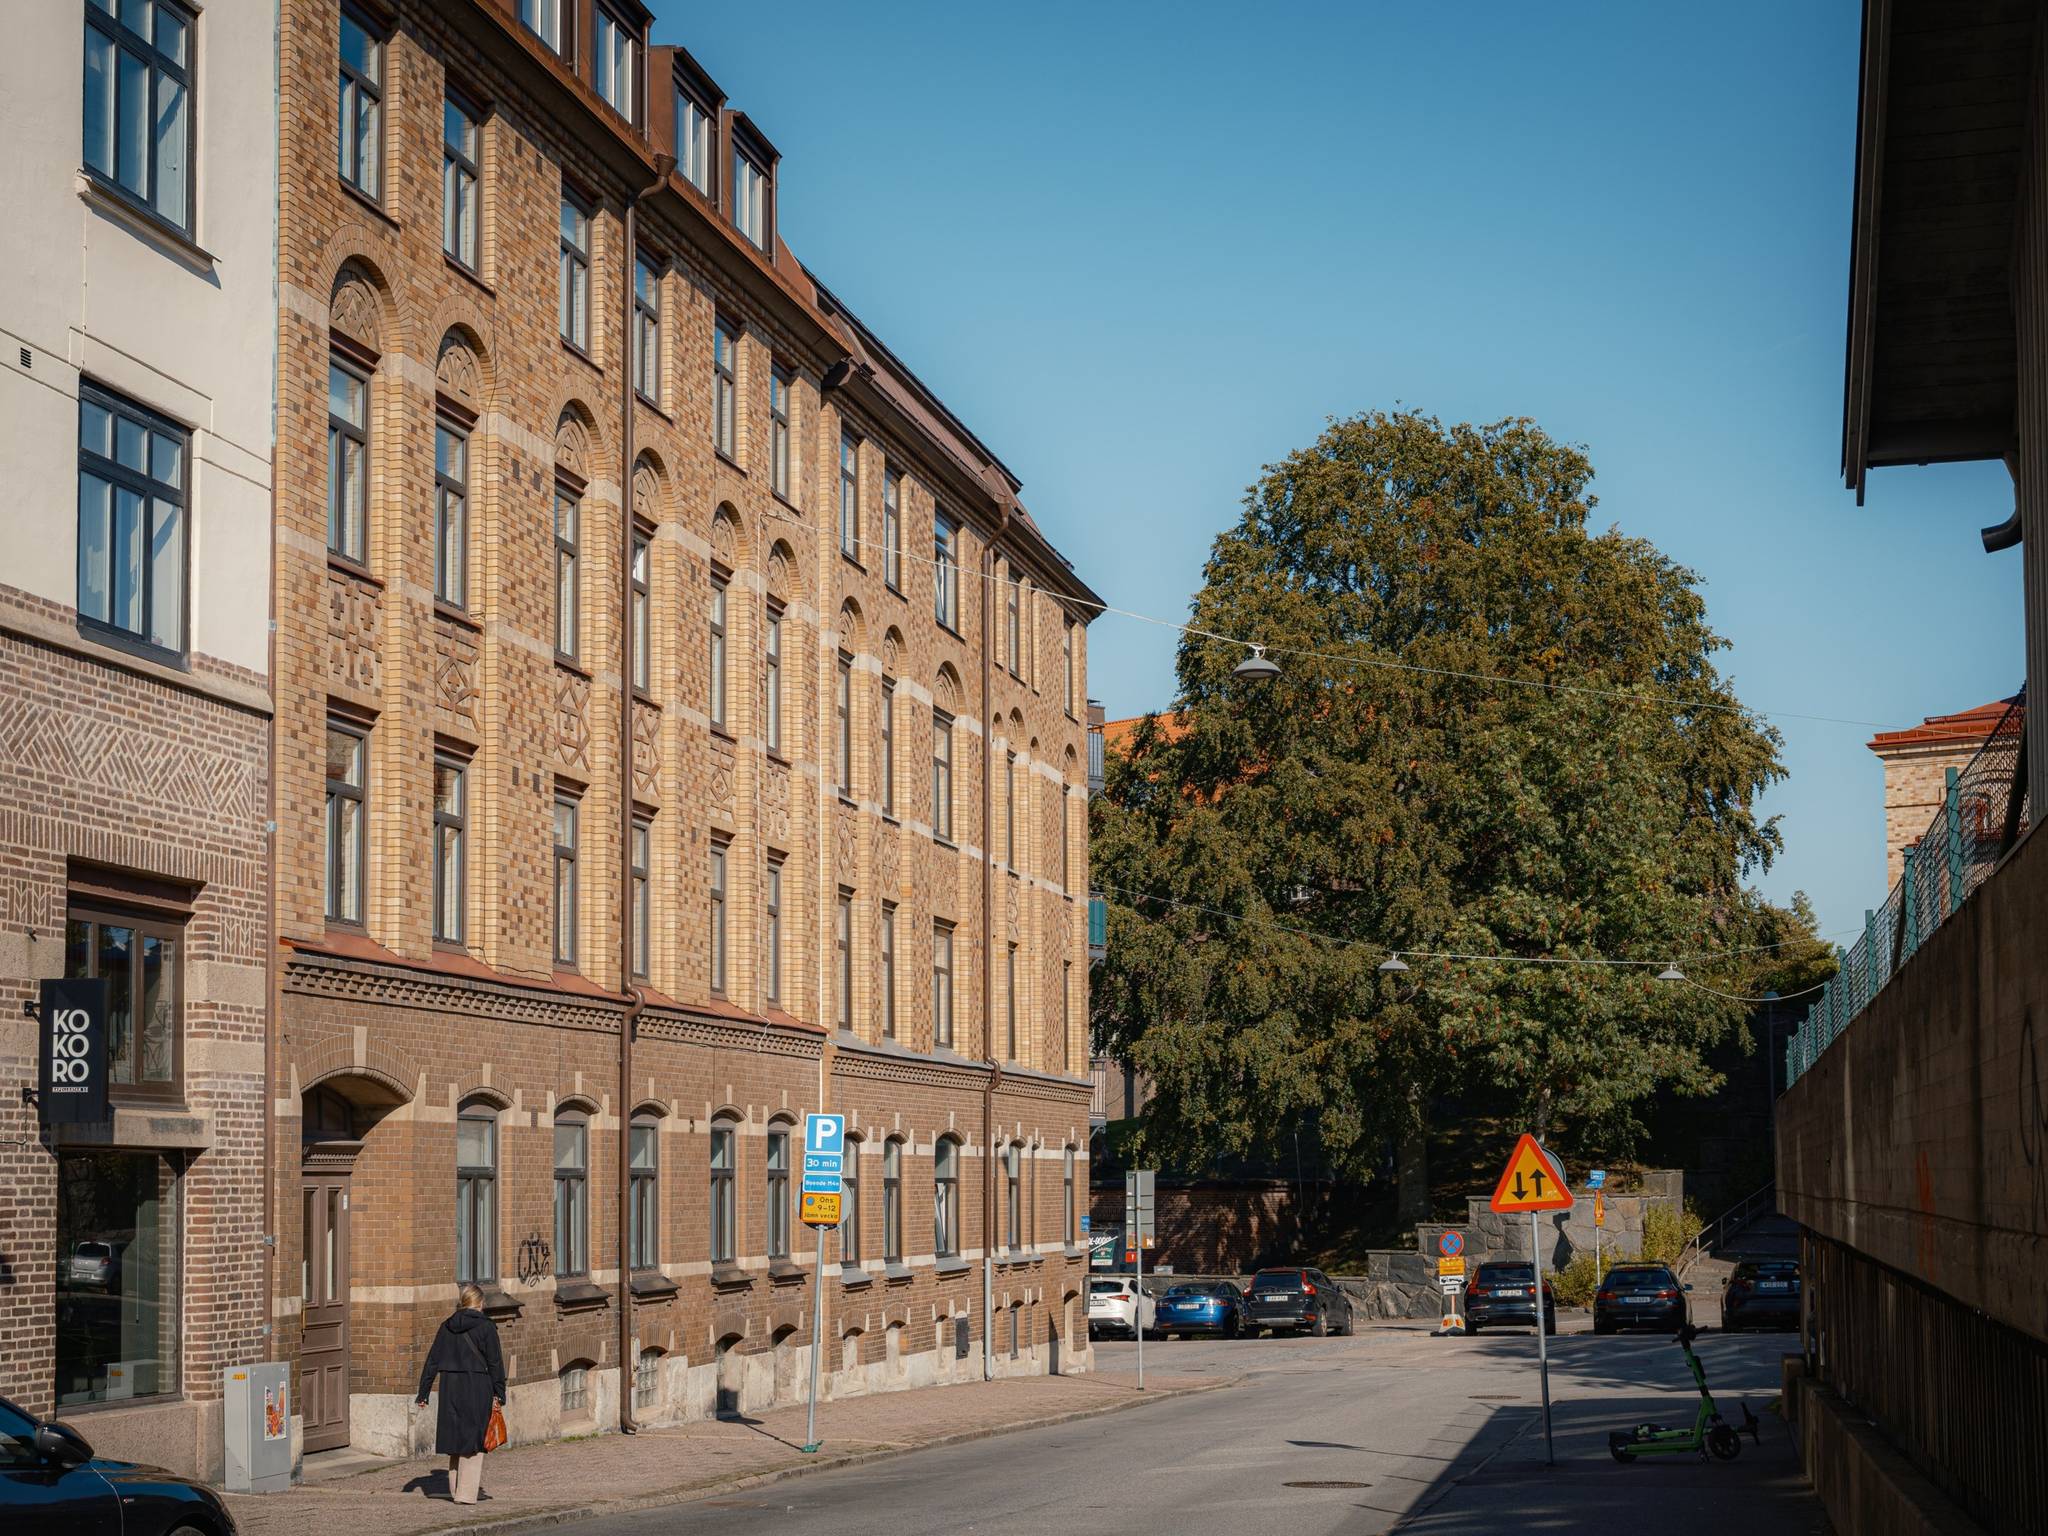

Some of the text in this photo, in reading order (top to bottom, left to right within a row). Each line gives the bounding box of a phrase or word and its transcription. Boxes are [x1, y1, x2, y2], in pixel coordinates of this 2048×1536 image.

[53, 1009, 90, 1033] KO
[52, 1034, 90, 1058] KO
[52, 1058, 89, 1083] RO
[815, 1118, 837, 1149] P
[807, 1158, 837, 1168] 30 min
